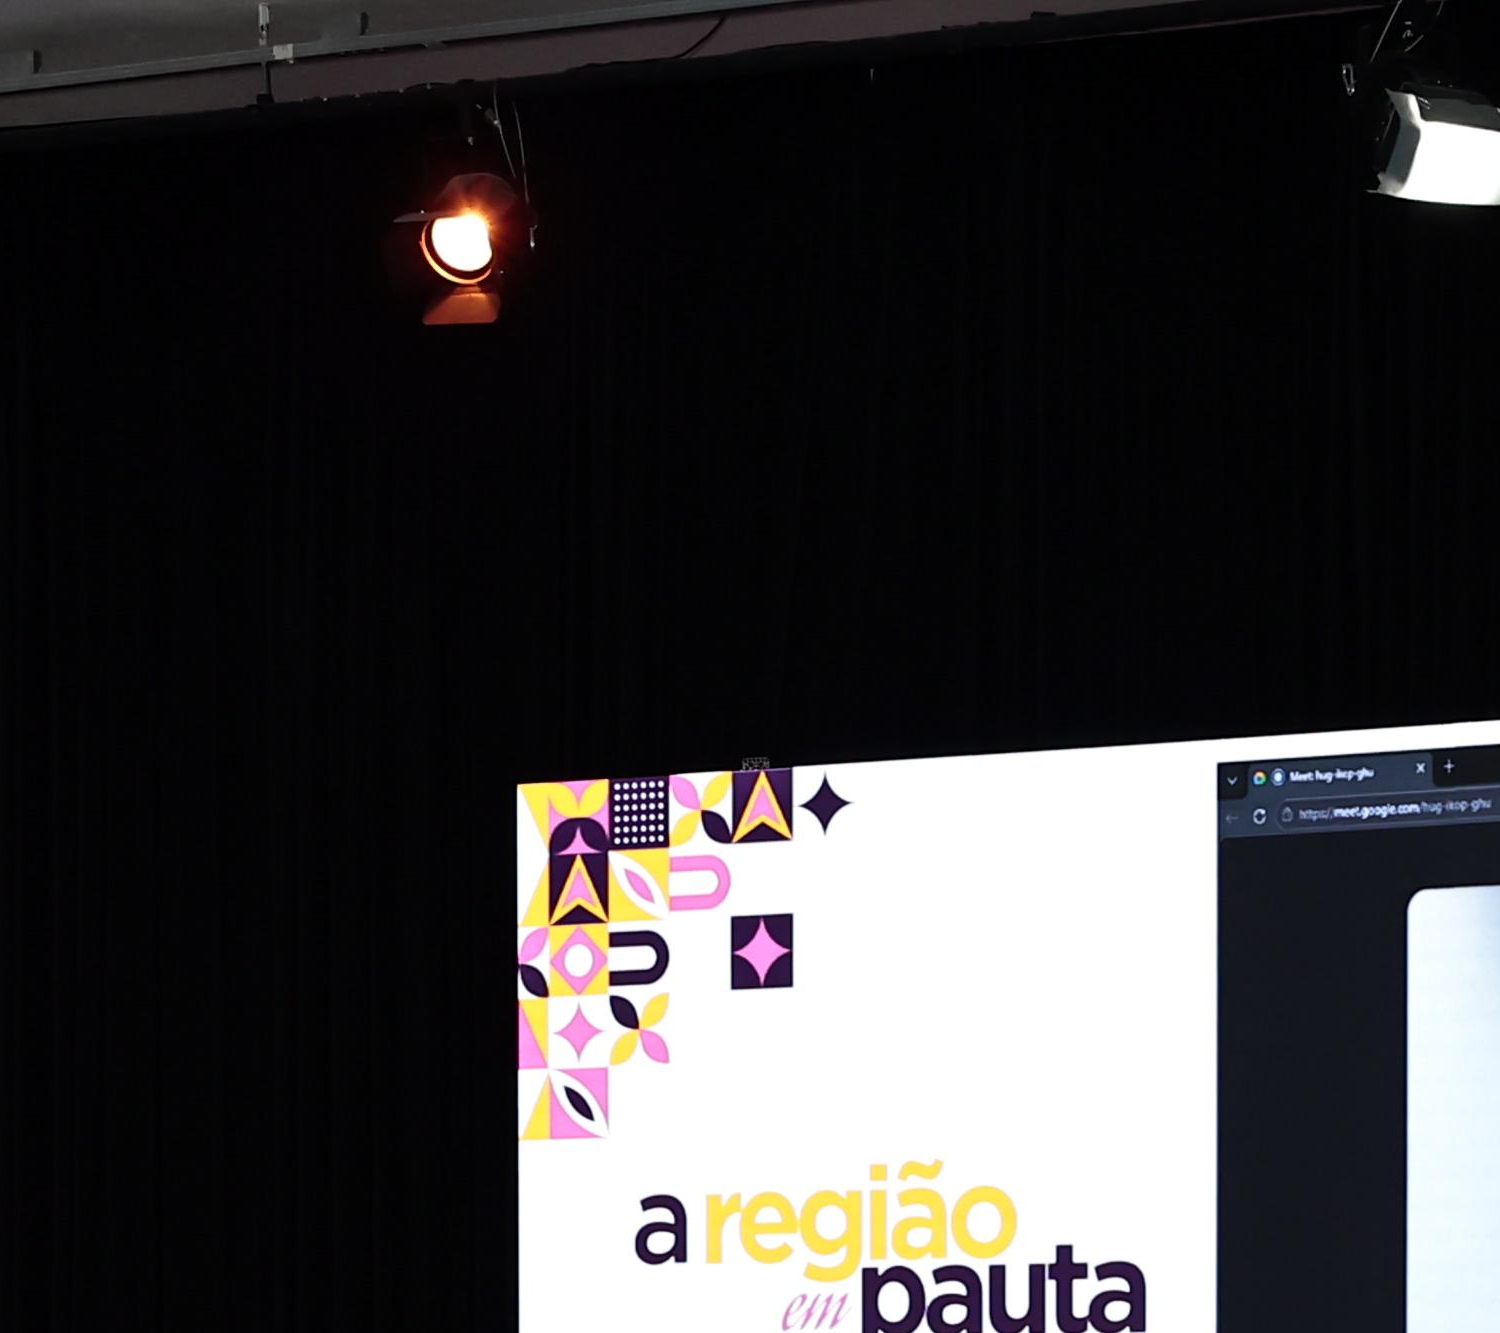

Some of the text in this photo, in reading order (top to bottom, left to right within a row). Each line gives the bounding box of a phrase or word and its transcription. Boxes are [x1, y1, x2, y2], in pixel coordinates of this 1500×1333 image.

[634, 1158, 1018, 1283] a região
[780, 1291, 851, 1333] em
